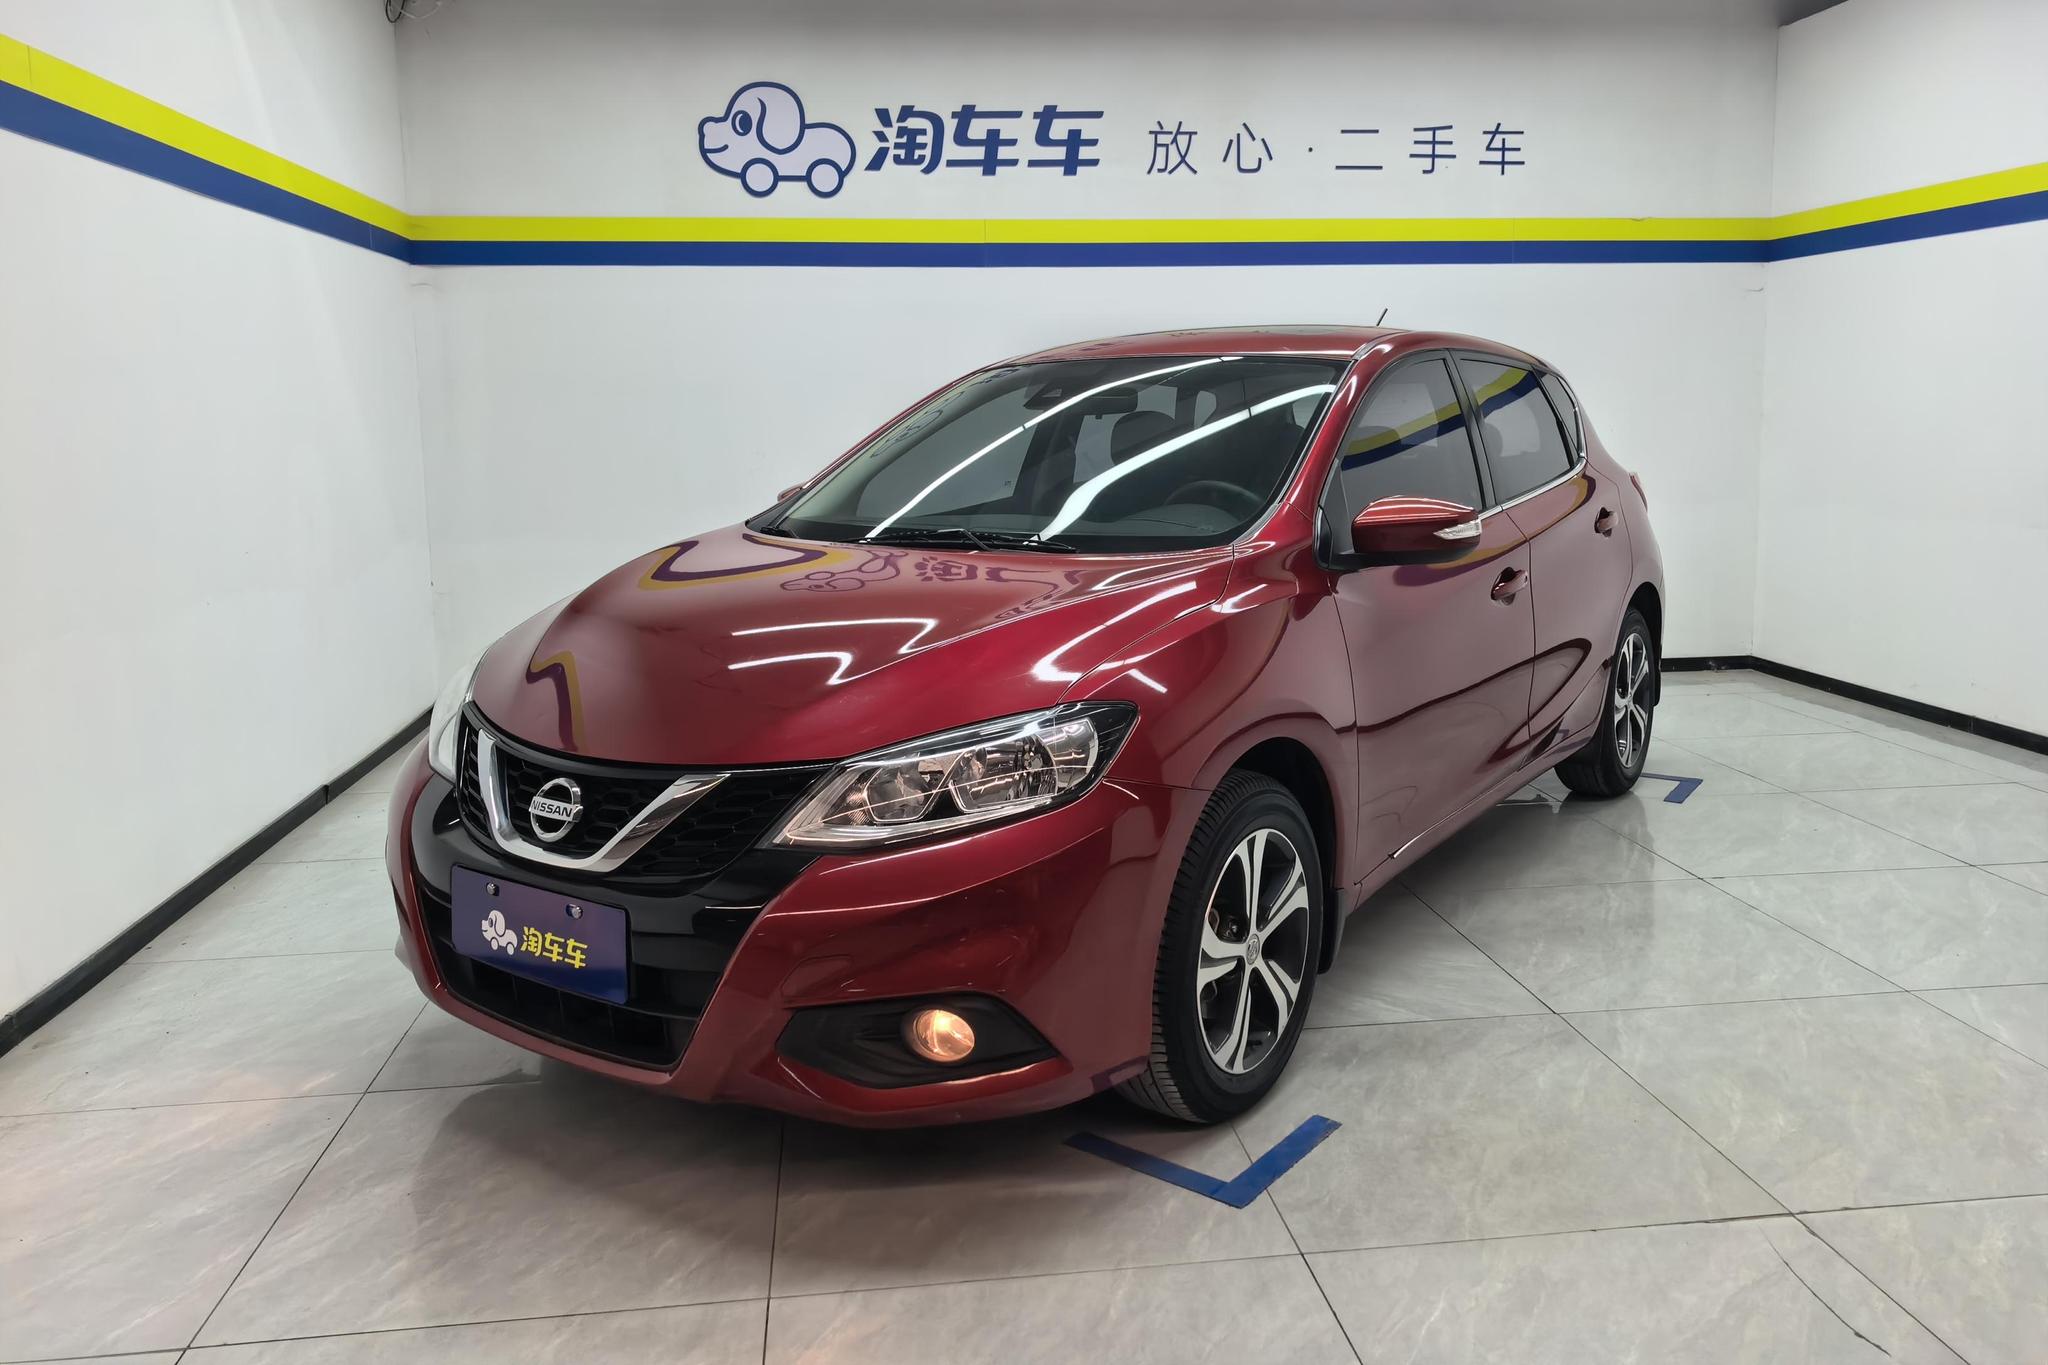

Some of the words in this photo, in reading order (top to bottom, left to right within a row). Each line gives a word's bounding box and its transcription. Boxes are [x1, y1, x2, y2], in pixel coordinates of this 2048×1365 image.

[864, 104, 1105, 176] 淘车车
[531, 799, 573, 818] NISSAN
[520, 926, 588, 969] 淘车车
